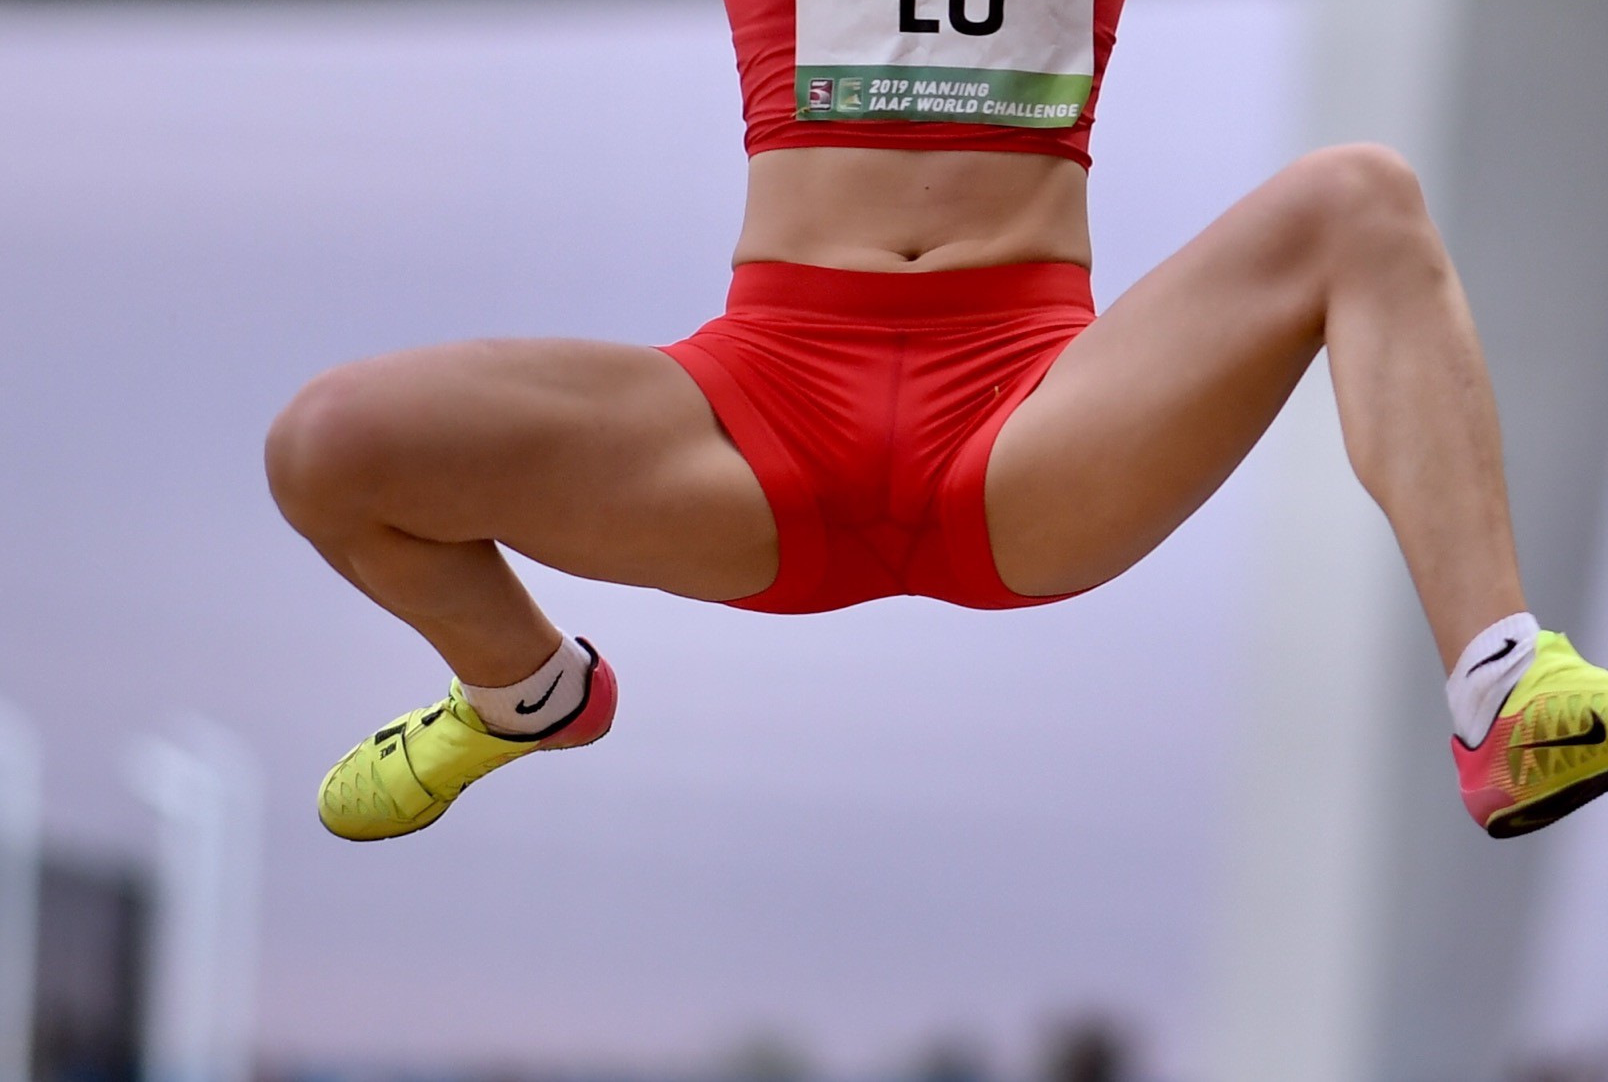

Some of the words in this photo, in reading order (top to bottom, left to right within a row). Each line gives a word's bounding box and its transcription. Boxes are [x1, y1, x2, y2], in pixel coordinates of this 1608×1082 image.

[869, 79, 909, 94] 2019
[912, 81, 990, 97] NANJING
[869, 96, 912, 111] IAAF
[916, 98, 978, 113] WORLD
[982, 100, 1079, 118] CHALLENGE
